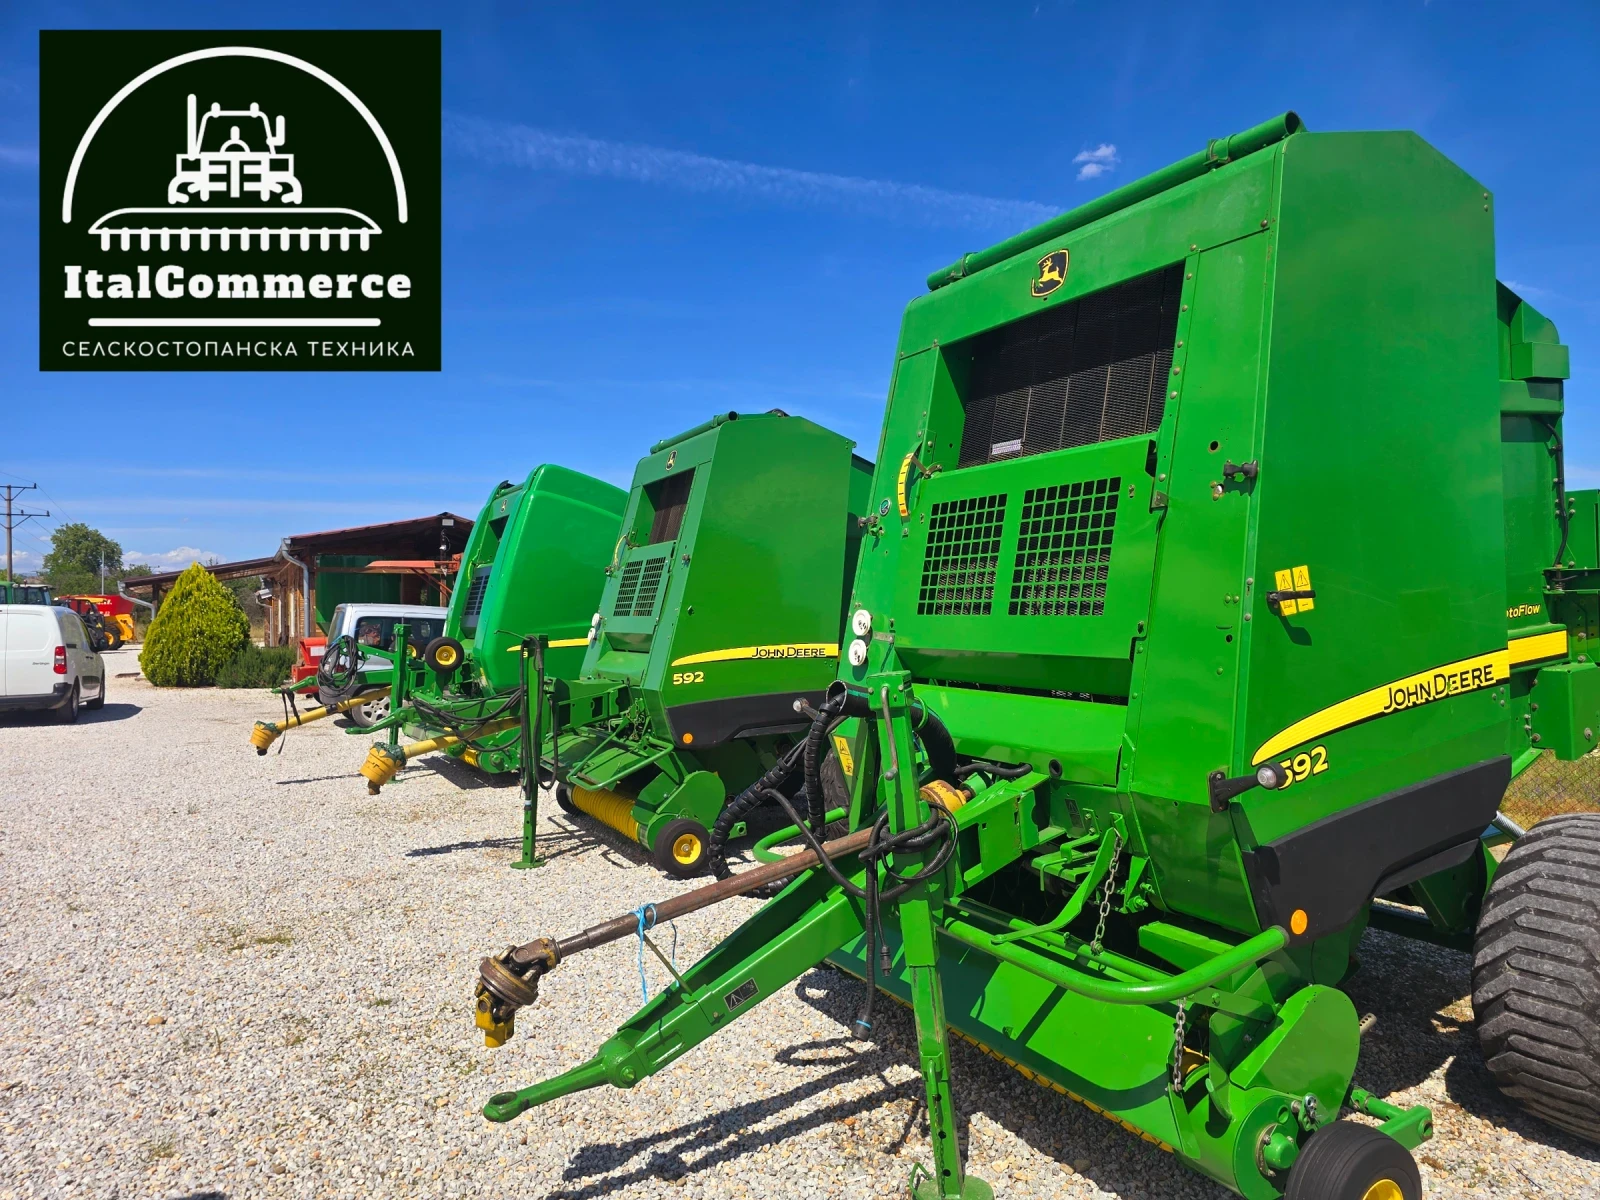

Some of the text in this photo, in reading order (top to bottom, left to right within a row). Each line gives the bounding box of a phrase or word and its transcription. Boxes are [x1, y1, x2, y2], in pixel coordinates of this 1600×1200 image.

[751, 645, 827, 659] JOHN DEERE
[672, 671, 705, 685] 592
[1383, 663, 1497, 713] JOHN DEERE
